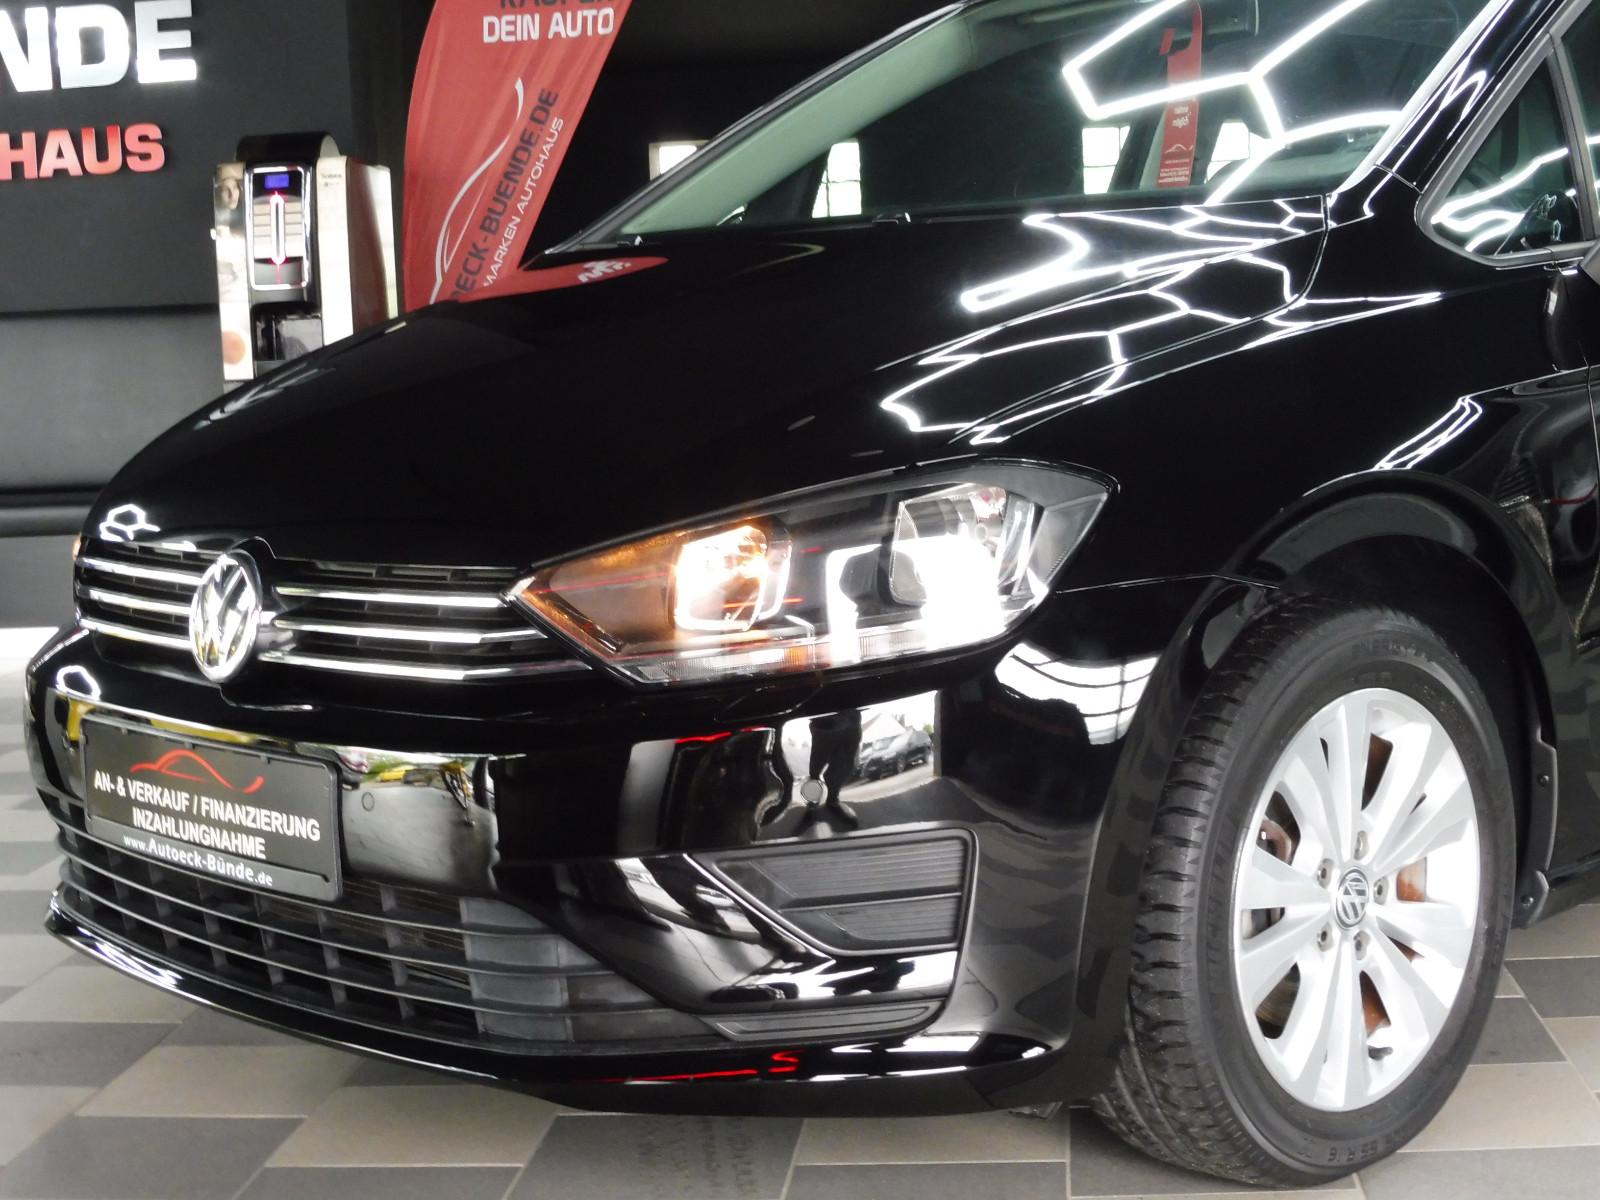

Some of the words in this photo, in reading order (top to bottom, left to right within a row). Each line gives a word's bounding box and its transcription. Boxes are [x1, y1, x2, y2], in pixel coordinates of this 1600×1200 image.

[483, 13, 540, 43] DEIN
[548, 7, 615, 39] AUTO
[0, 123, 165, 180] HAUS
[520, 117, 565, 215] AUTOHAUS
[94, 770, 115, 792] AN-
[117, 780, 126, 798] &
[127, 778, 191, 813] VERKAUF
[192, 794, 199, 813] /
[201, 798, 321, 842] FINANZIERUNG
[132, 807, 267, 860] INZAHLUNGNAHME
[123, 835, 273, 887] www.Autoeck-Bünde.de
